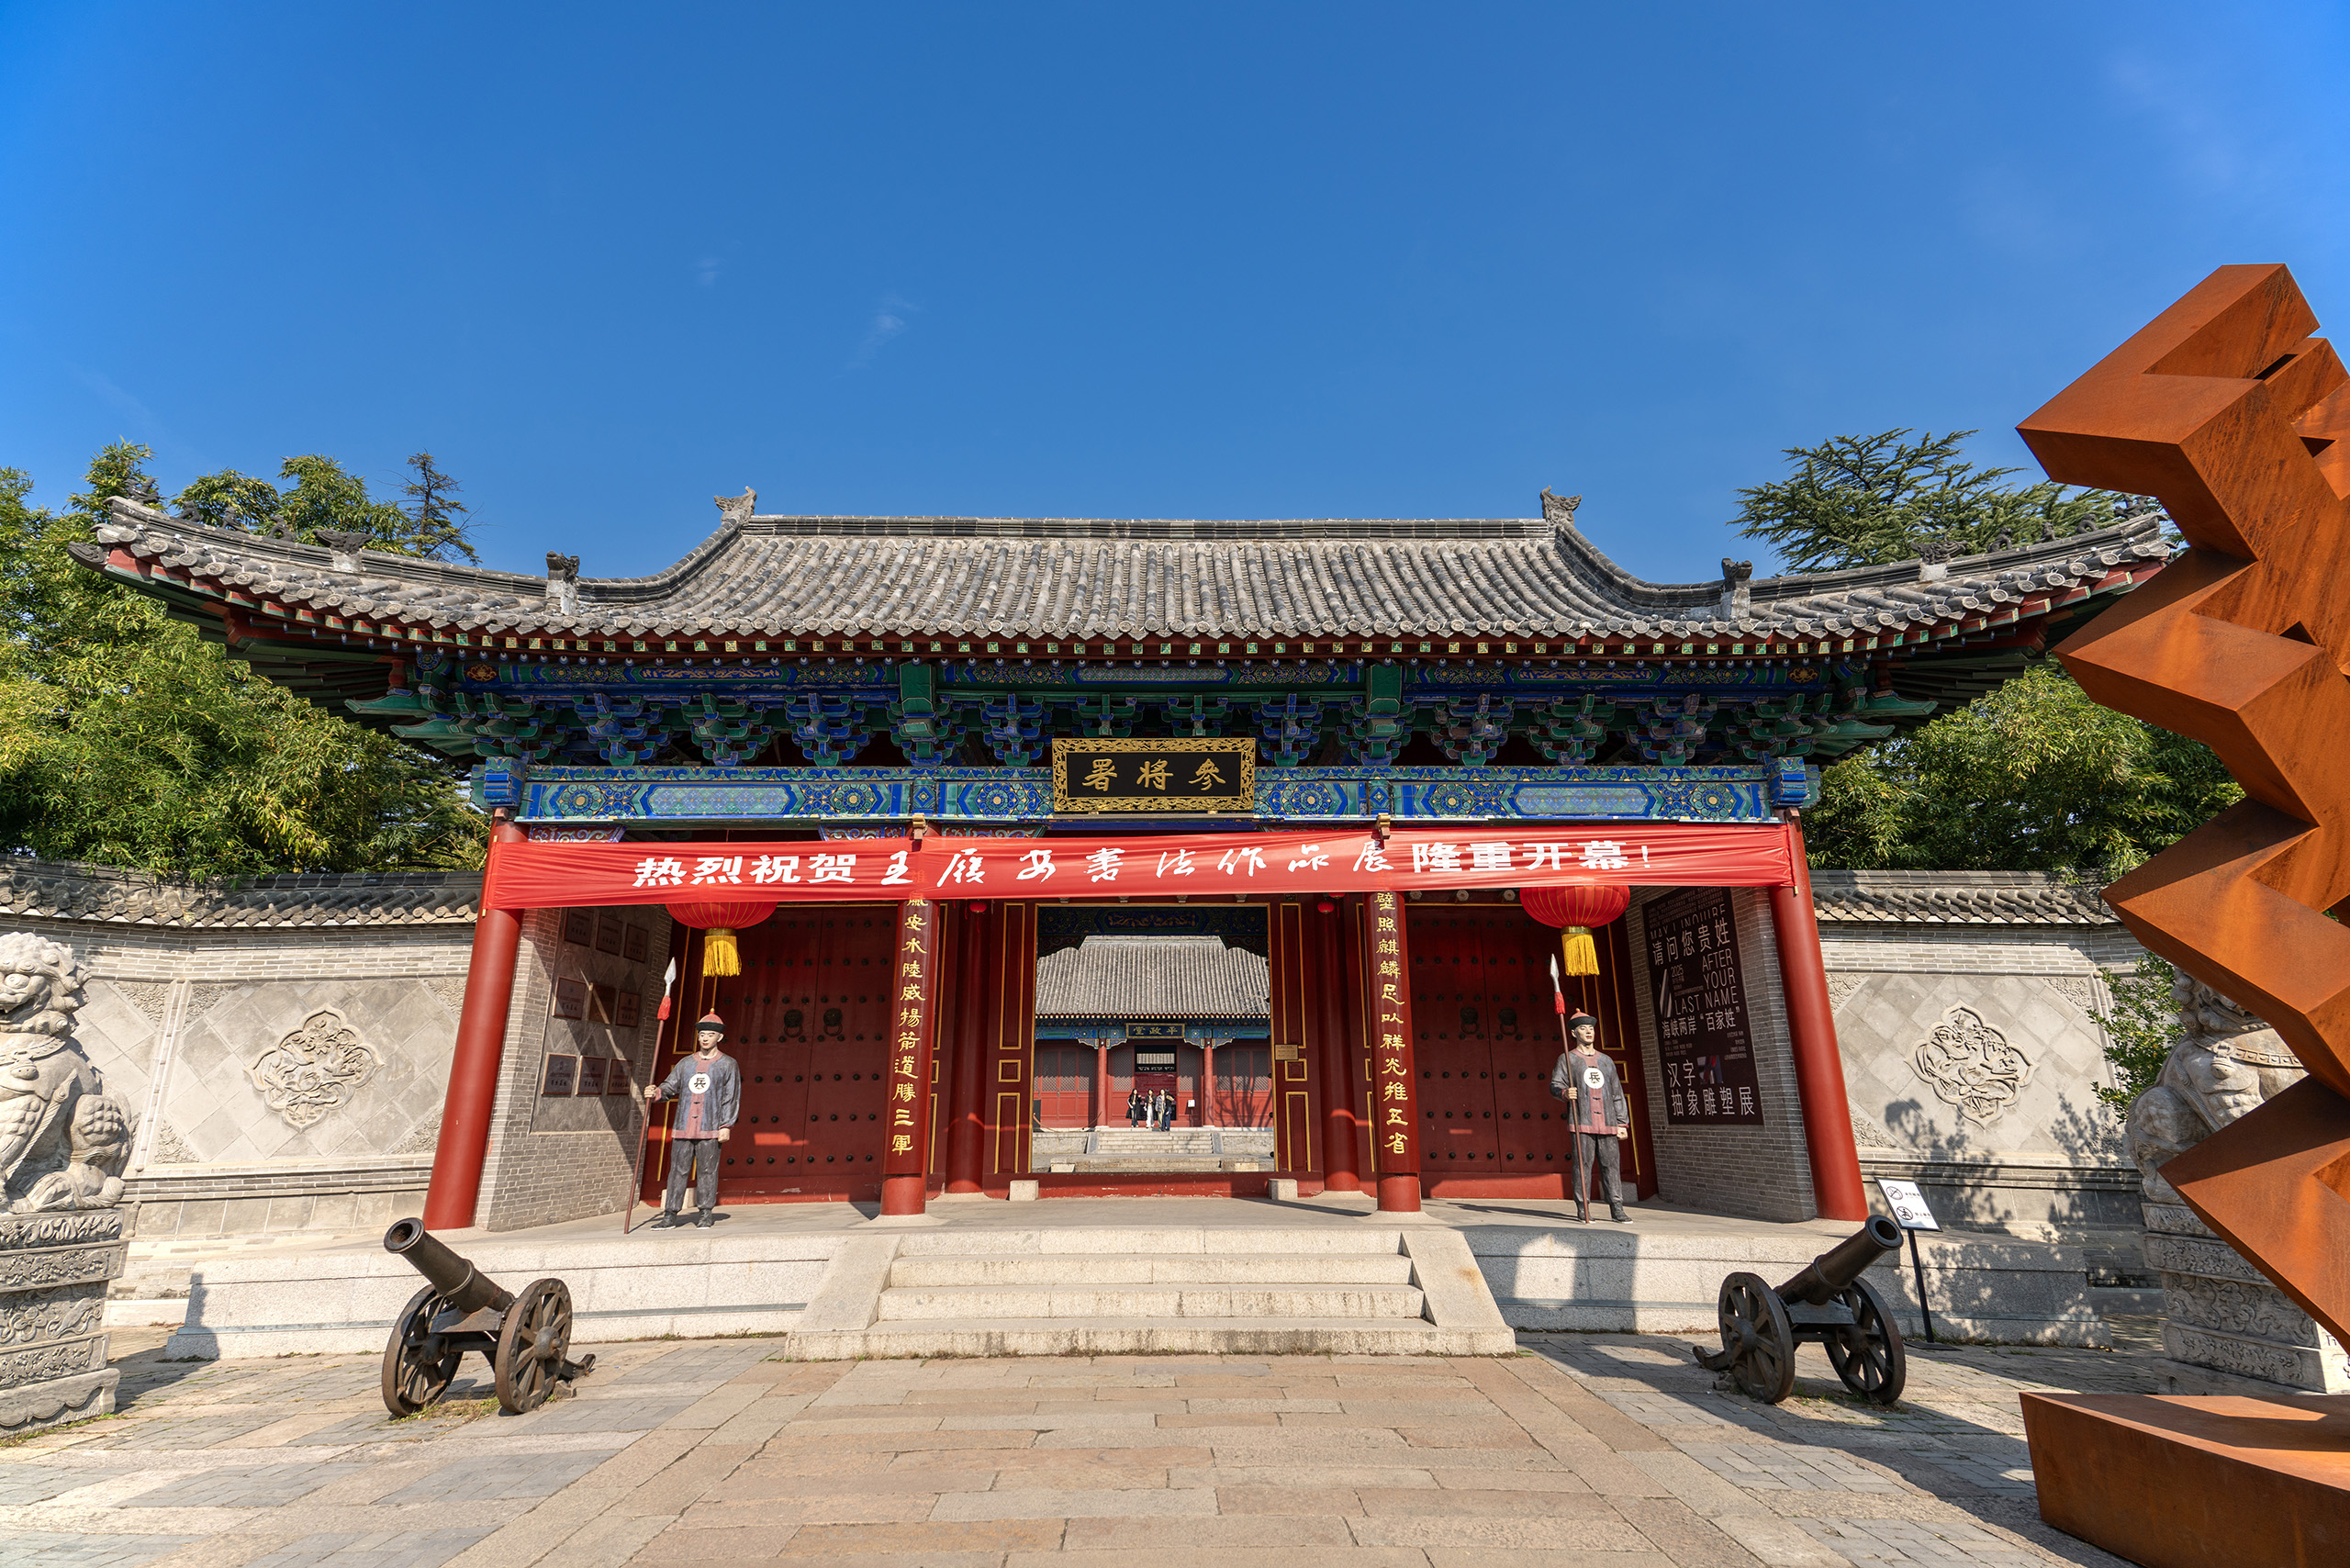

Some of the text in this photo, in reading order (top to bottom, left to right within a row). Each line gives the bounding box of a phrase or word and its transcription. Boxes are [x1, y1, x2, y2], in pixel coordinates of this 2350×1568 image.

[1652, 917, 1730, 966] 请问您贵姓
[1671, 964, 1684, 978] 2025
[1702, 948, 1733, 972] AFTER
[1703, 967, 1736, 990] YOUR
[1674, 994, 1700, 1015] LAST
[1705, 985, 1739, 1009] NAME
[1667, 1059, 1695, 1088] 汉字
[1671, 1086, 1755, 1116] 抽象雕塑展
